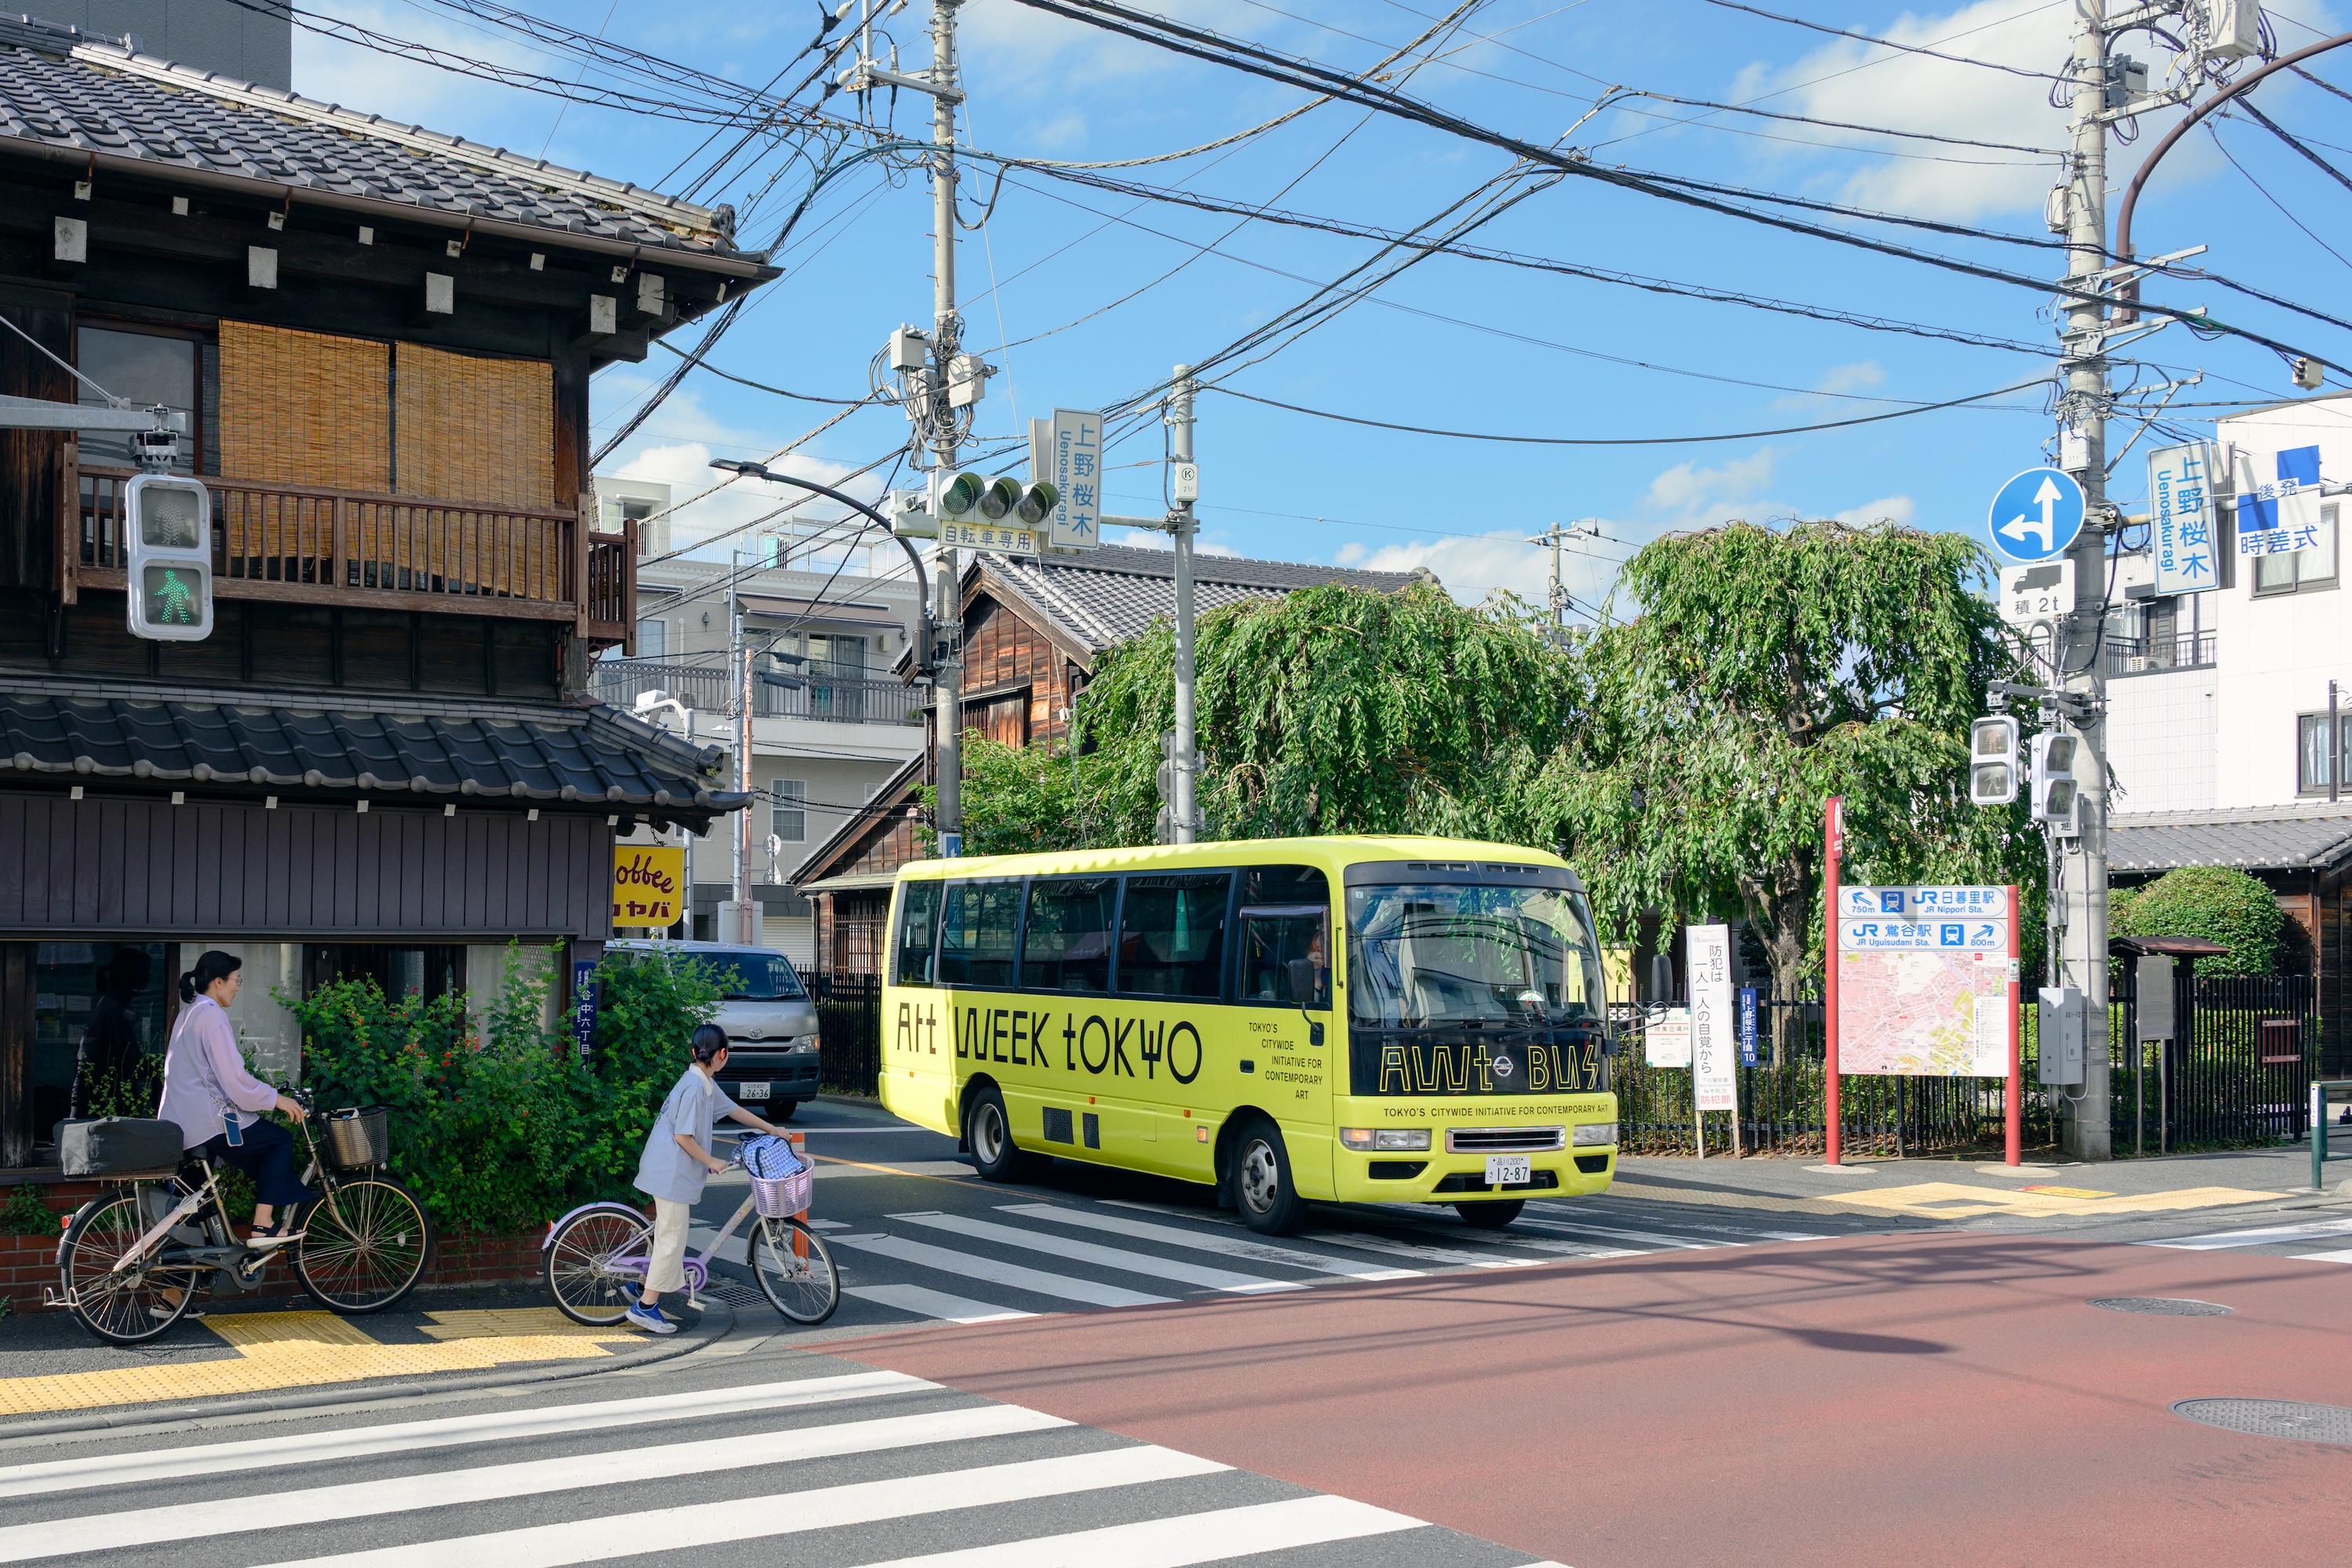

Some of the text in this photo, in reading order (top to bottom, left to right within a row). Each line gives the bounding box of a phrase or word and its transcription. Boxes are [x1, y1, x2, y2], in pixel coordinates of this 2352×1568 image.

[1058, 431, 1072, 526] Uenosakuragi
[1072, 423, 1095, 537] 上野桜木
[2259, 480, 2297, 499] 後発
[2158, 470, 2177, 572] Uenosakuragi
[2176, 456, 2209, 579] 上野桜木
[946, 524, 1031, 550] 自転車専用
[2241, 525, 2318, 555] 時差式
[614, 854, 675, 894] offee
[1911, 891, 1994, 904] JR 日暮里駅
[1937, 906, 1965, 914] Nippori
[1853, 924, 1878, 937] JR
[1869, 938, 1912, 947] Uguisudani
[1709, 945, 1723, 982] 防犯は
[581, 989, 591, 1055] 谷中六丁目
[1694, 963, 1712, 1074] 一人一人の自覚から
[1249, 1022, 1278, 1033] TOKYO'S
[954, 1007, 1050, 1068] WEEK
[1261, 1039, 1294, 1050] CITYWIDE
[1272, 1055, 1322, 1069] INITIATIVE FOR
[1744, 1053, 1755, 1062] 10
[1265, 1070, 1323, 1085] CONTEMPORARY
[1295, 1089, 1308, 1100] ART
[1700, 1095, 1731, 1105] 防犯部
[1384, 1104, 1609, 1116] TOKYO'S CITYWIDE INITIATIVE FOR CONTEMPORARY ART
[1497, 1167, 1528, 1181] 12-87
